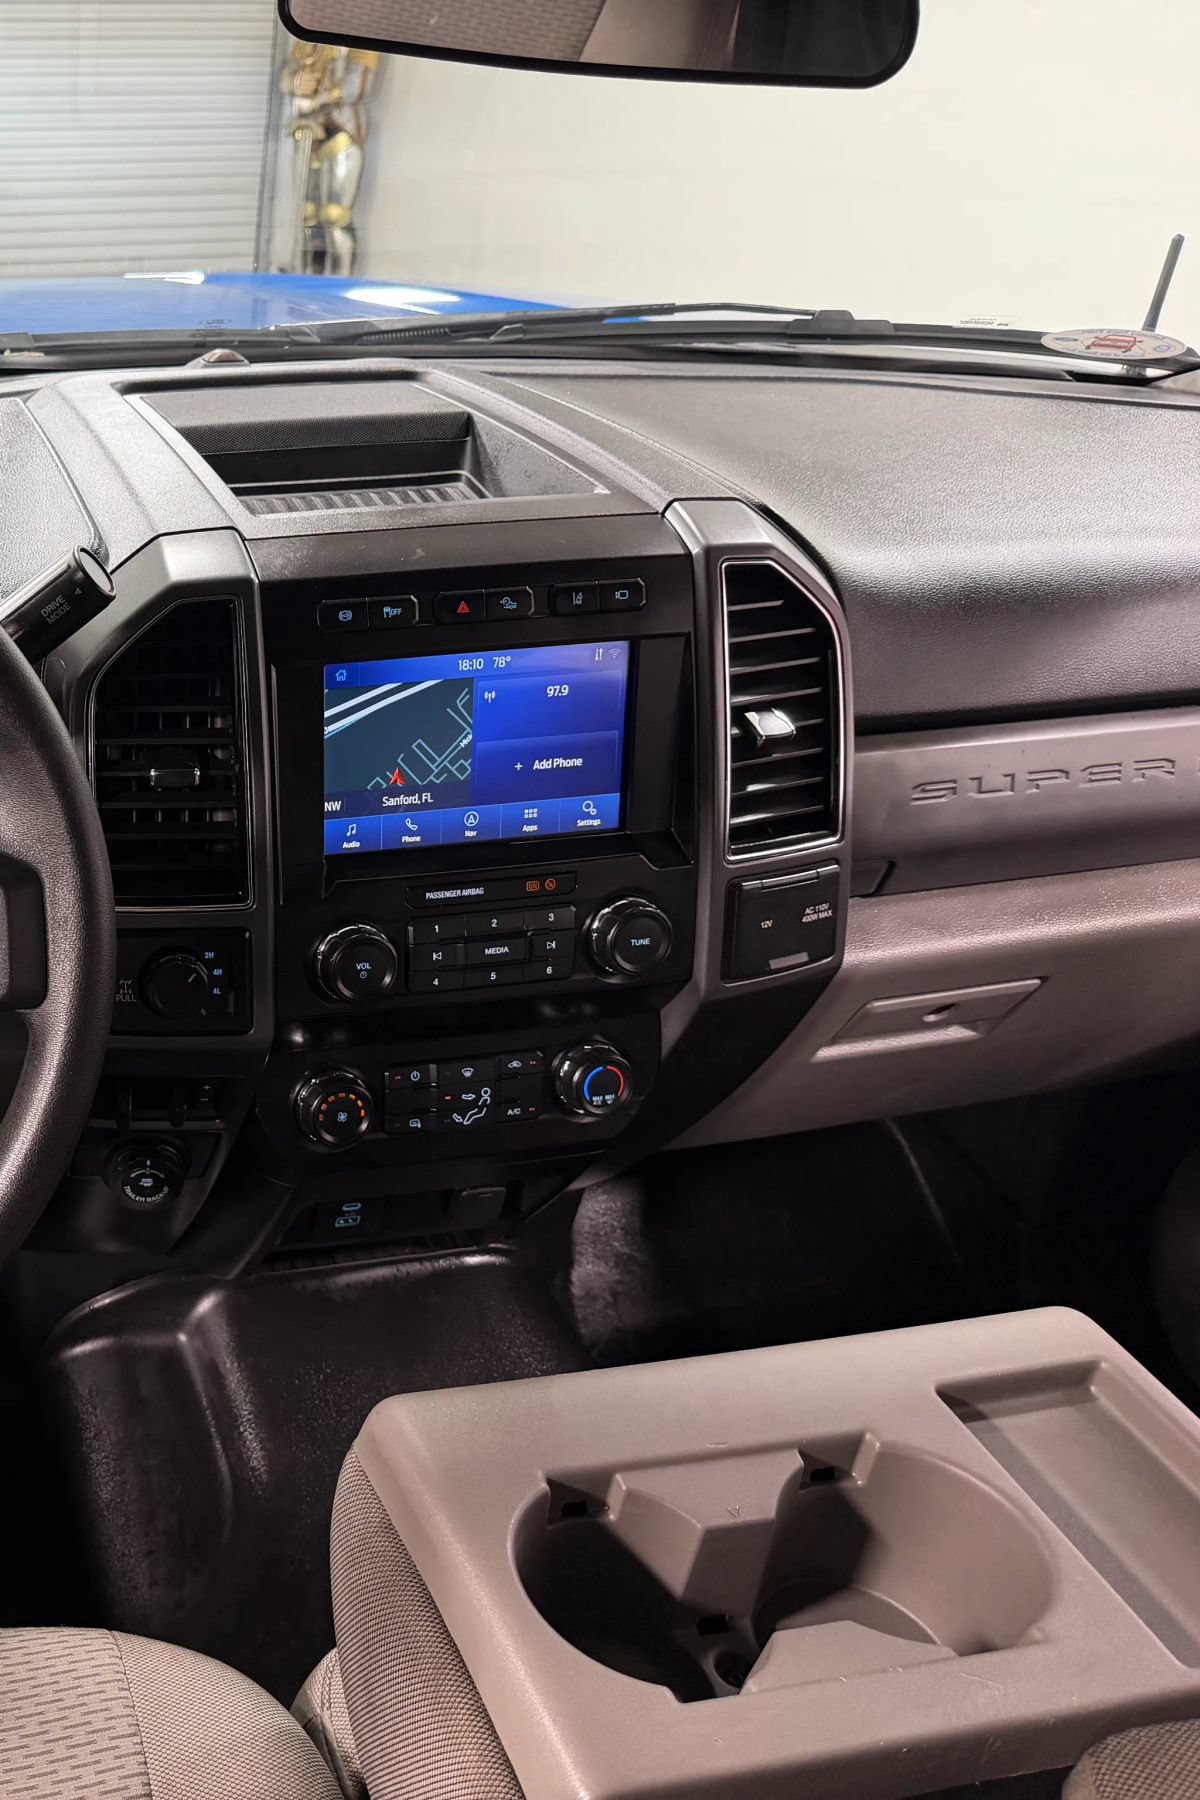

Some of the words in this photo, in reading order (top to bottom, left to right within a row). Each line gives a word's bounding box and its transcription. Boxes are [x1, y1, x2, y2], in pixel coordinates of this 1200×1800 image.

[40, 594, 66, 617] DRIVE
[46, 602, 72, 625] MODE
[390, 607, 403, 616] OFF
[458, 659, 484, 671] 18:10
[492, 656, 511, 668] 78°
[546, 685, 569, 697] 97.9
[533, 757, 552, 770] Add
[553, 756, 583, 769] Phone
[910, 757, 1176, 805] SUPER
[382, 794, 420, 808] Sanford,
[422, 793, 434, 804] FL
[324, 800, 342, 812] NW
[576, 817, 601, 829] Settings
[464, 829, 477, 837] Nav
[522, 824, 538, 834] Apps
[401, 834, 421, 843] Phone
[342, 839, 360, 849] Audio
[425, 888, 461, 900] PASSENGER
[462, 887, 485, 898] AIRBAG
[804, 905, 815, 915] AC
[815, 903, 830, 912] 110V
[548, 913, 555, 922] 3
[801, 912, 819, 923] 400W
[819, 909, 833, 919] MAX
[491, 918, 498, 928] 2
[761, 920, 773, 928] 12V
[433, 924, 440, 933] 1
[630, 937, 651, 947] TUNE
[484, 945, 509, 956] MEDIA
[355, 962, 372, 971] VOL
[546, 966, 553, 975] 6
[490, 971, 497, 981] 5
[432, 977, 439, 986] 4
[115, 994, 136, 1002] PULL
[507, 1107, 521, 1116] A/C
[123, 1185, 145, 1202] TRAILER
[146, 1185, 169, 1202] BACKUP
